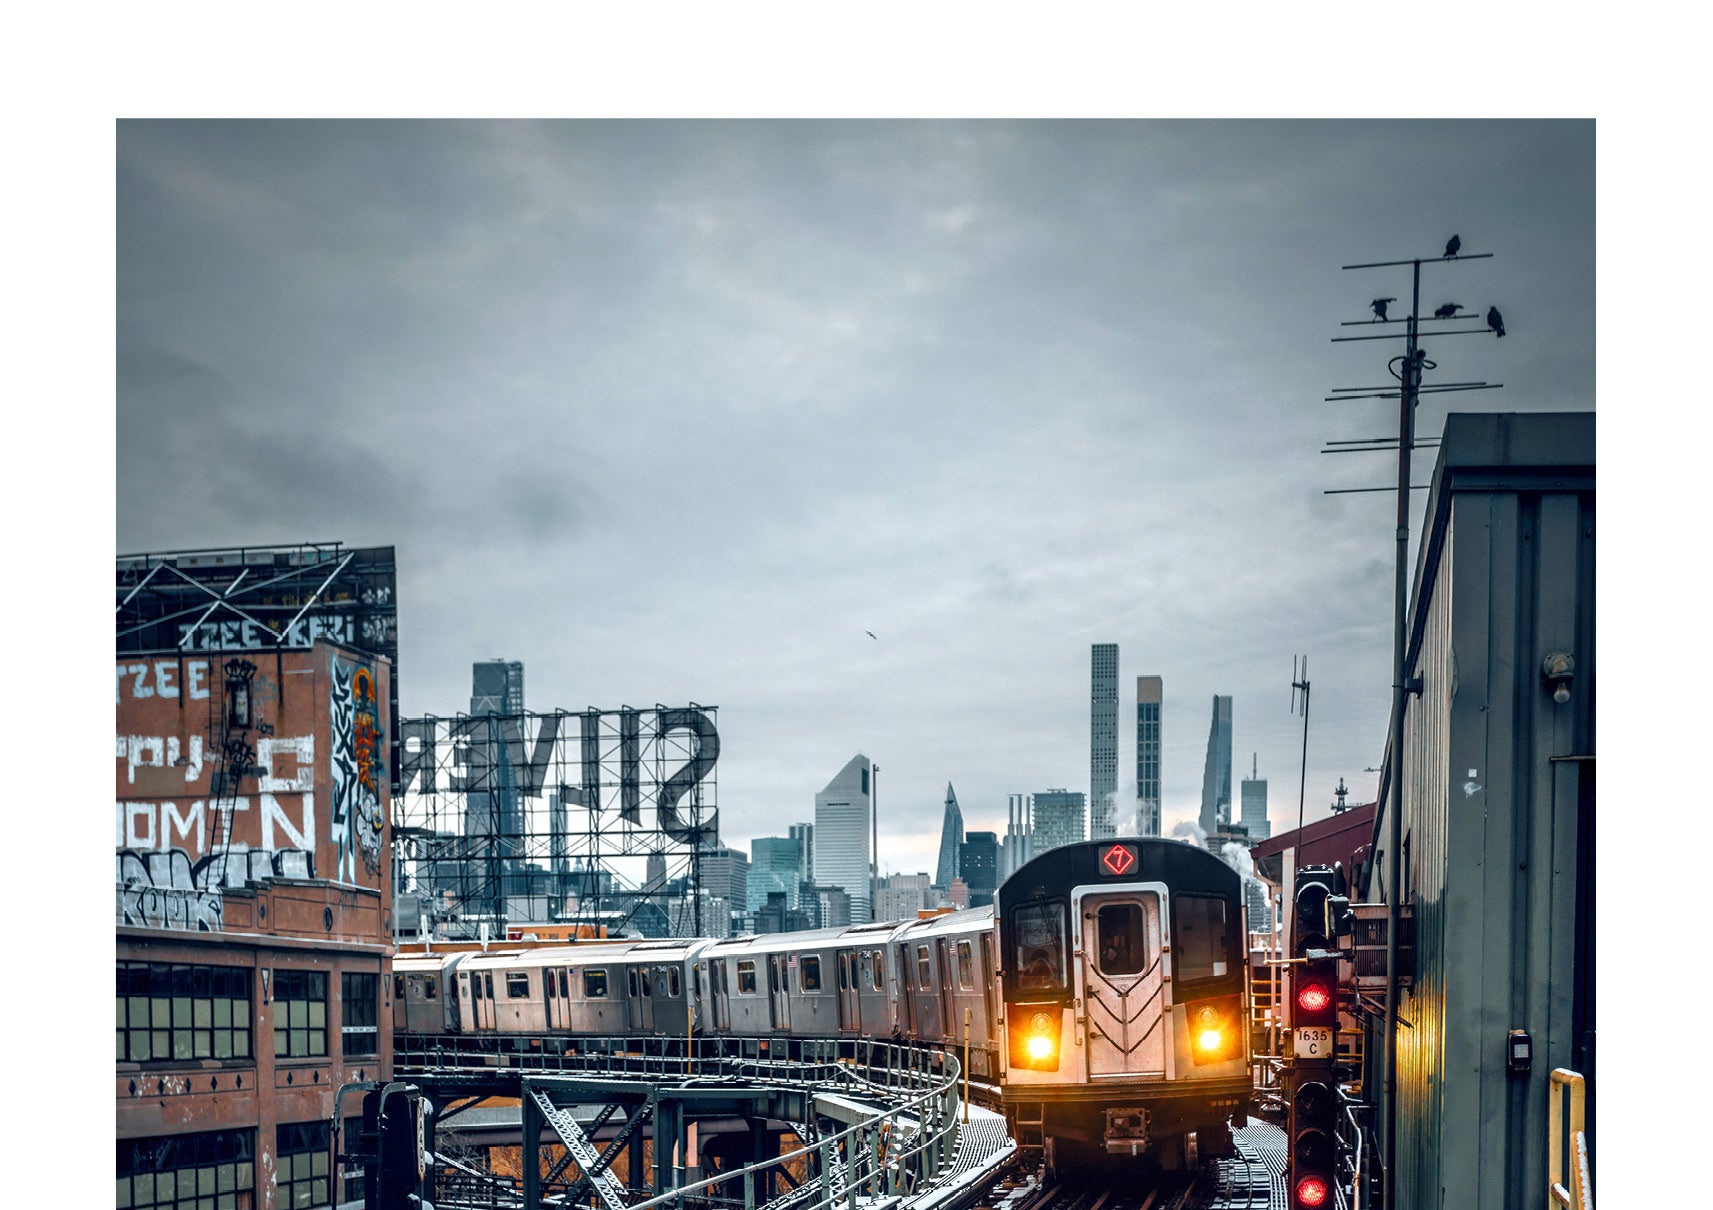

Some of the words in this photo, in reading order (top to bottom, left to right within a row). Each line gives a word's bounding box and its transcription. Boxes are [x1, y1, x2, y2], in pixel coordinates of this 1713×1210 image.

[1113, 850, 1124, 868] 7
[1299, 1030, 1328, 1041] 1635
[1309, 1043, 1318, 1055] C
